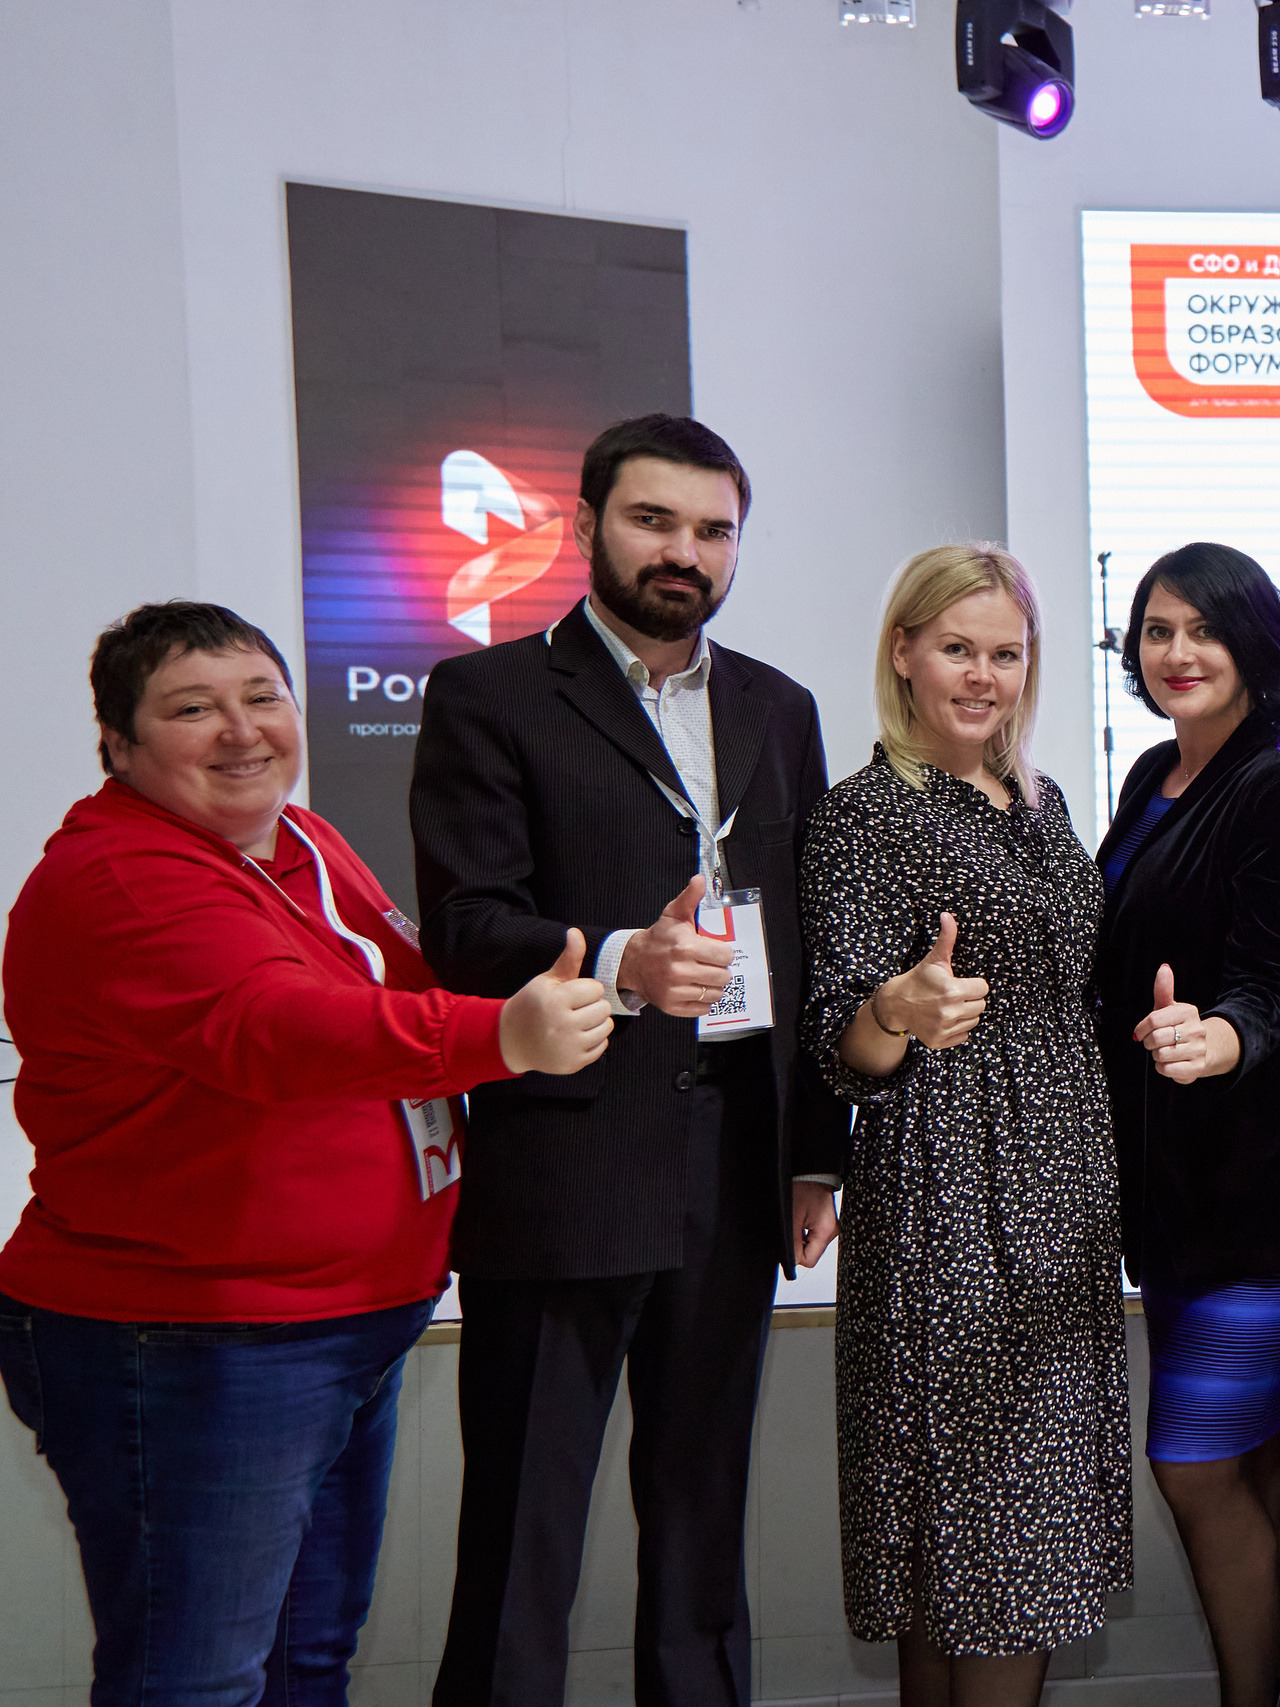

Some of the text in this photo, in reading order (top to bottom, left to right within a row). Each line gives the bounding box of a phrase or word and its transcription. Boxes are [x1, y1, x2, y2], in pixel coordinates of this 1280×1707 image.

[1188, 253, 1240, 274] СФО
[1244, 260, 1258, 273] и
[348, 723, 421, 738] програ
